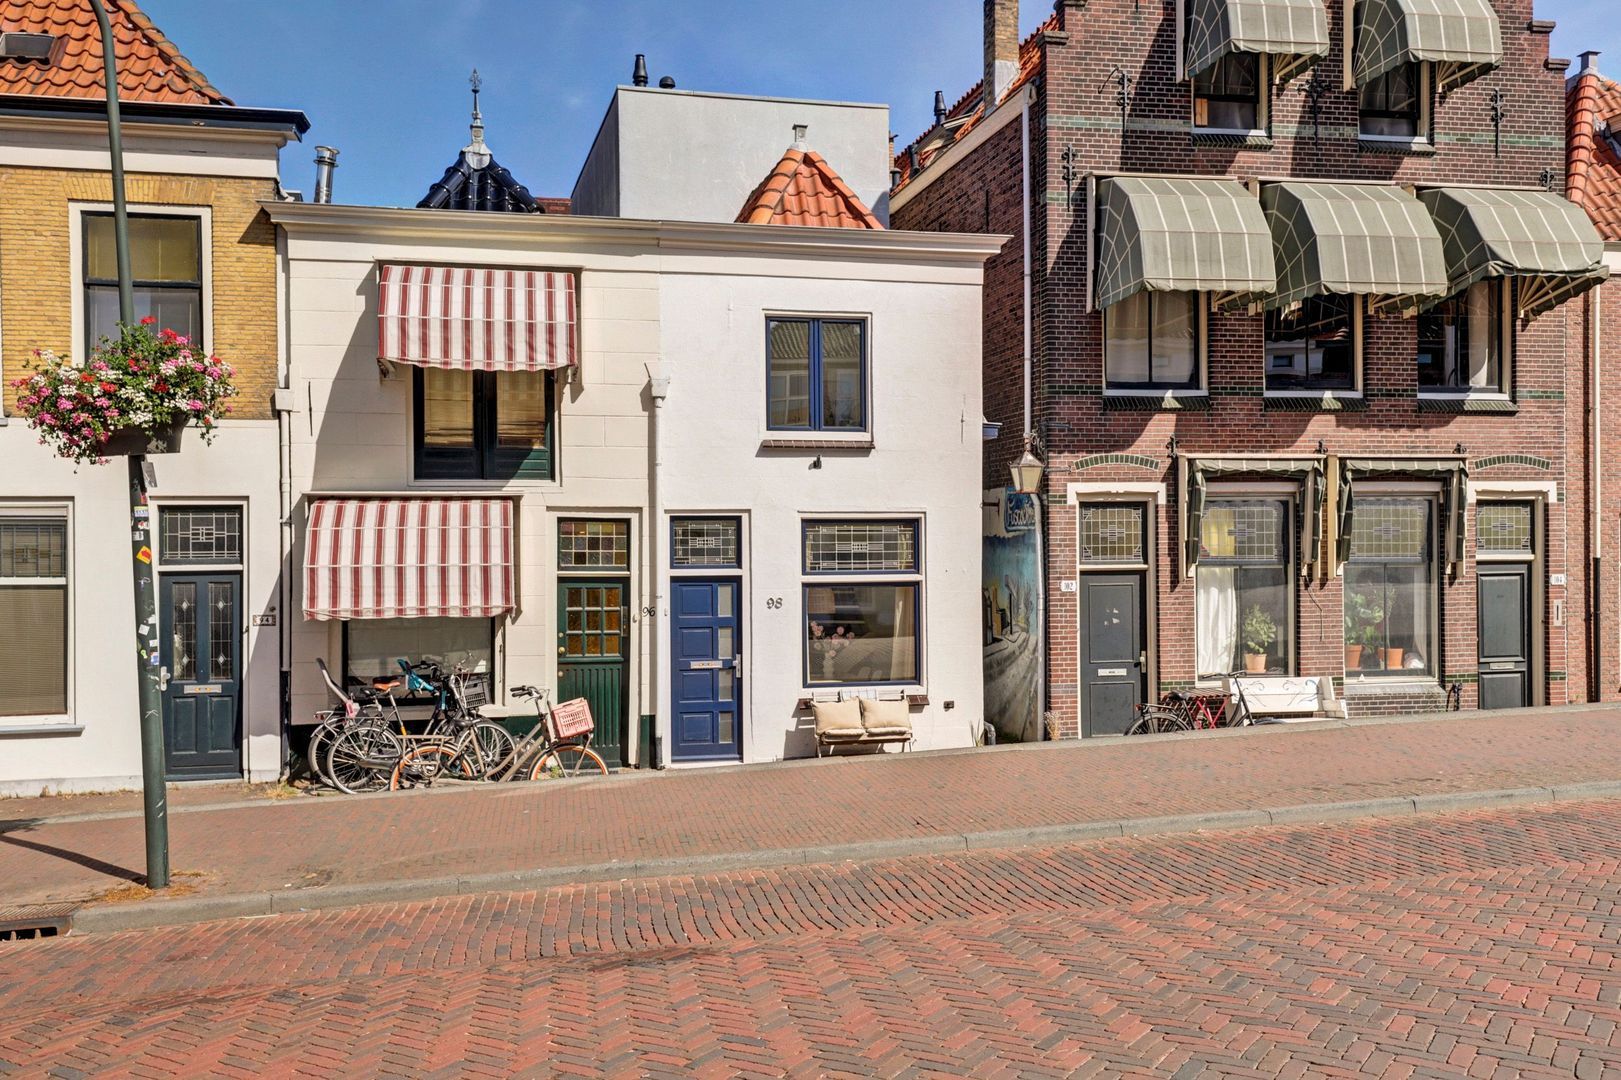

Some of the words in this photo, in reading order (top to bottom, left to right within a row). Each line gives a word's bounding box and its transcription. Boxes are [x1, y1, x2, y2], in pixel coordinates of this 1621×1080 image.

[766, 597, 783, 610] 98
[642, 606, 655, 617] 96
[260, 616, 269, 624] 94
